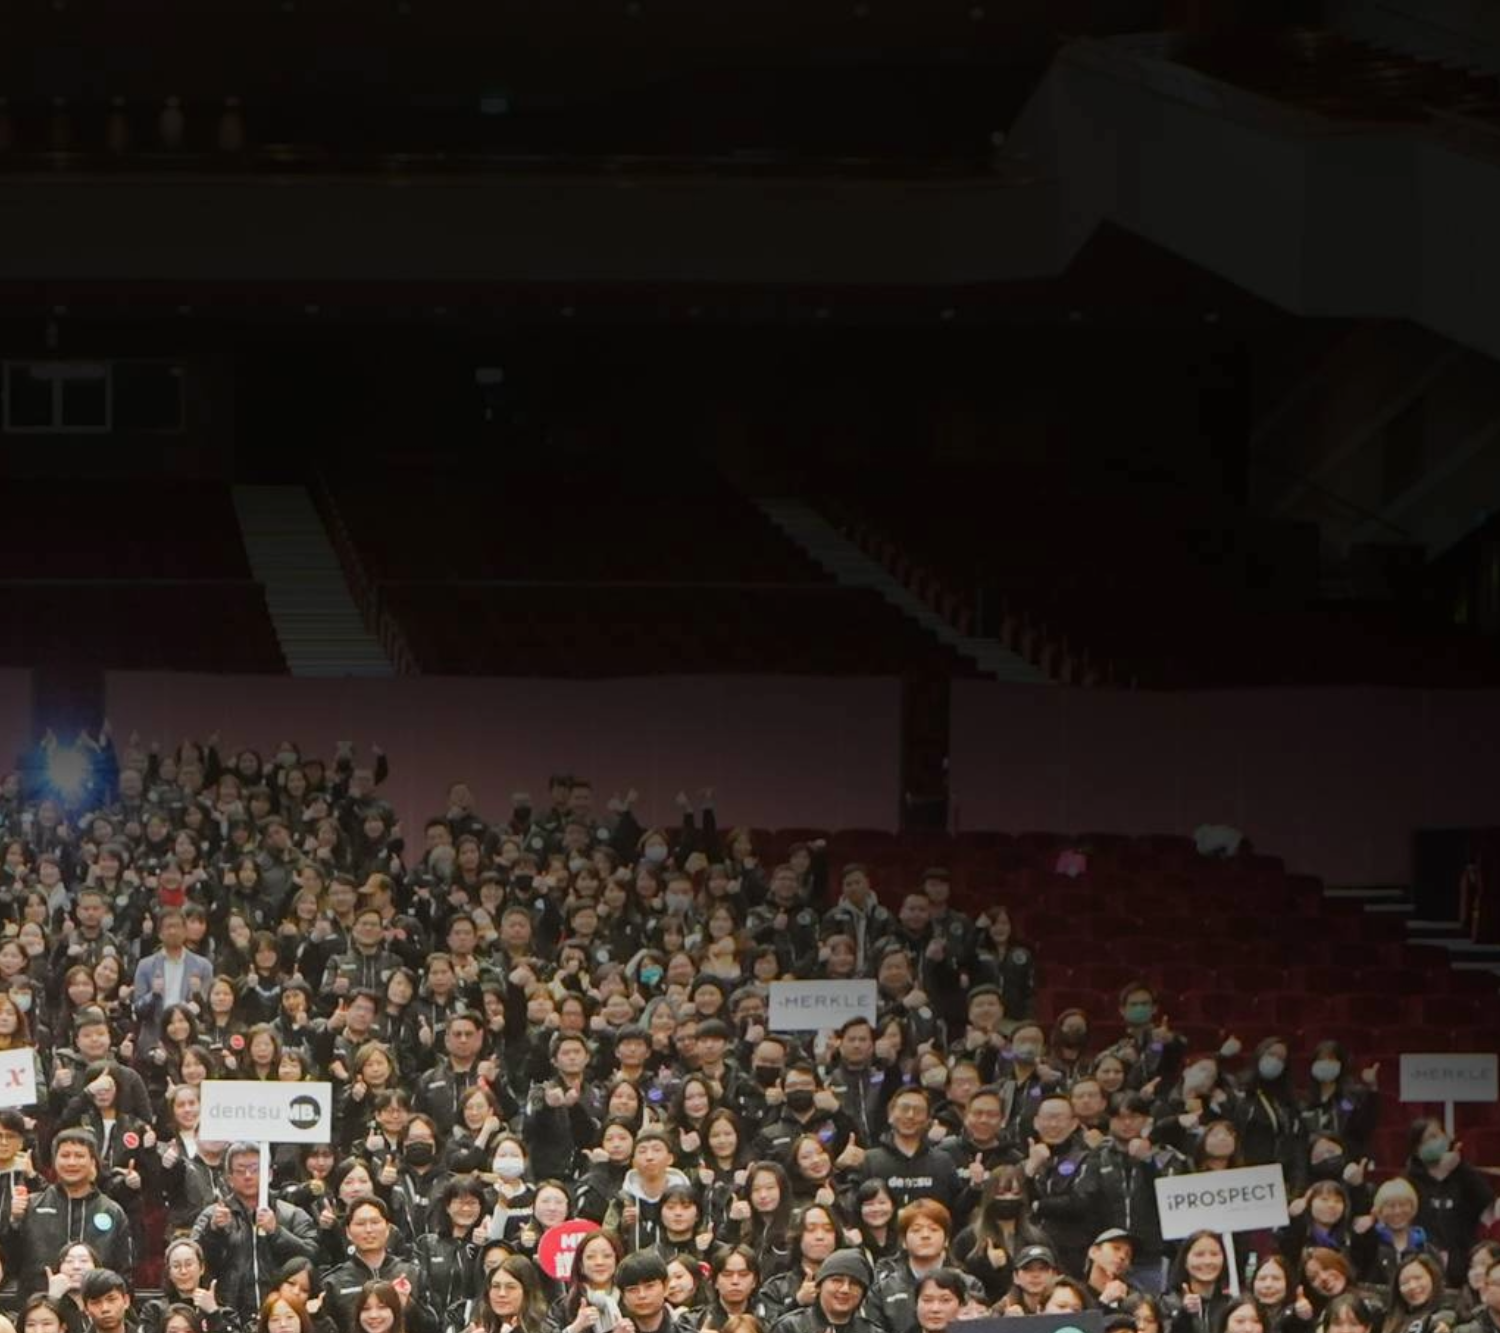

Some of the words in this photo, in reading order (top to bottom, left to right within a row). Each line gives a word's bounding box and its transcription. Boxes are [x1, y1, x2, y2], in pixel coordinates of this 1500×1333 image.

[783, 993, 869, 1008] MERKLE
[208, 1096, 282, 1120] dentsu
[1167, 1183, 1278, 1212] iPROSPECT
